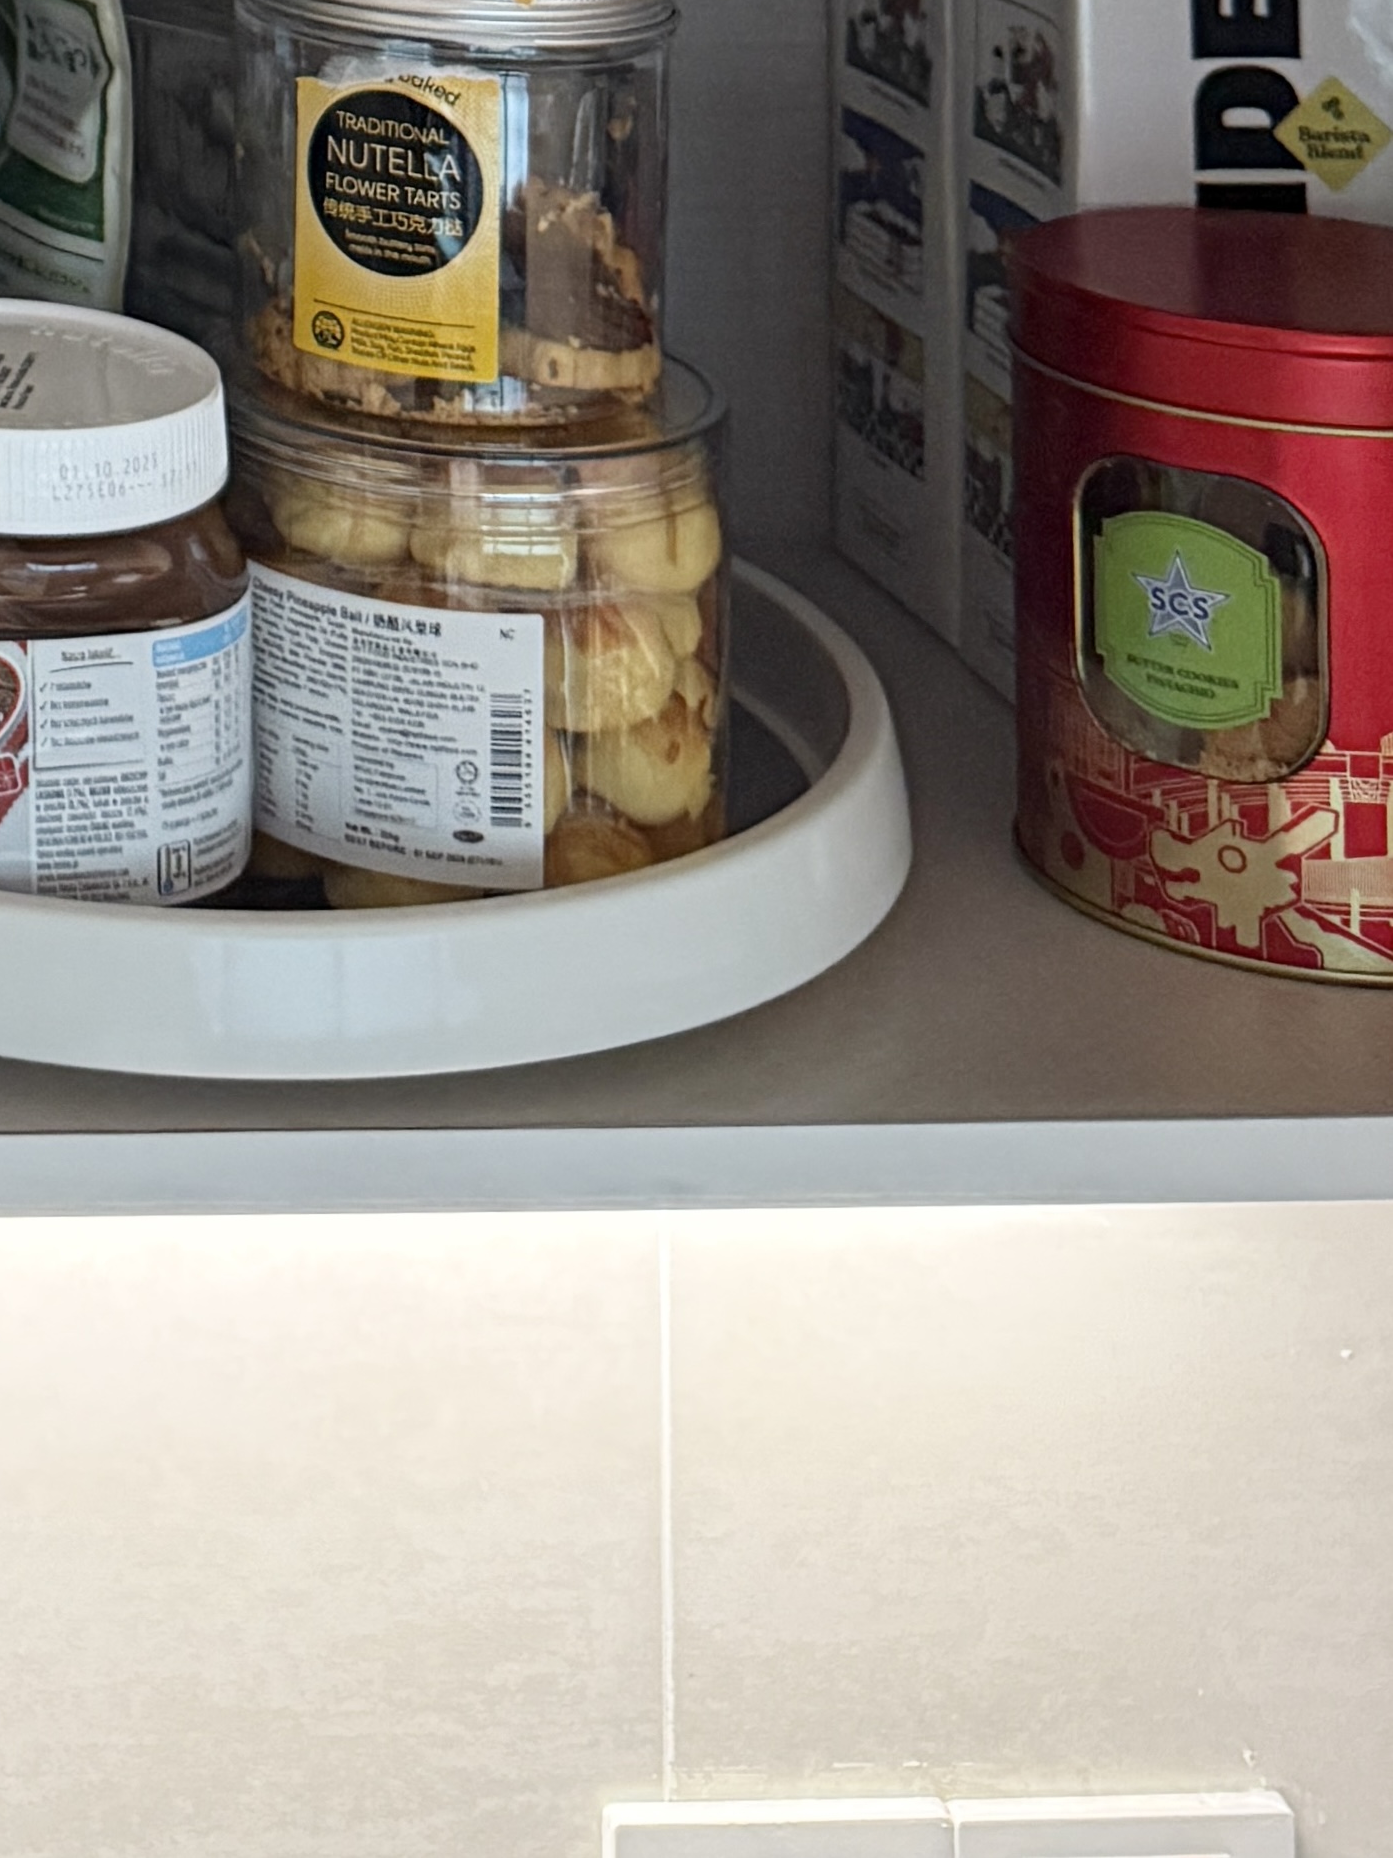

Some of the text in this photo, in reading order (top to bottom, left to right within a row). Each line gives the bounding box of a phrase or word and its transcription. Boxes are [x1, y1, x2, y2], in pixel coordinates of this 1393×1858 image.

[335, 110, 449, 146] TRADITIONAL
[1298, 127, 1371, 145] Barista
[326, 134, 461, 183] NUTELLA
[325, 171, 462, 211] FLOWER TARTS
[286, 589, 338, 618] Pineapple
[340, 604, 364, 625] Ball
[1151, 586, 1210, 621] SCS
